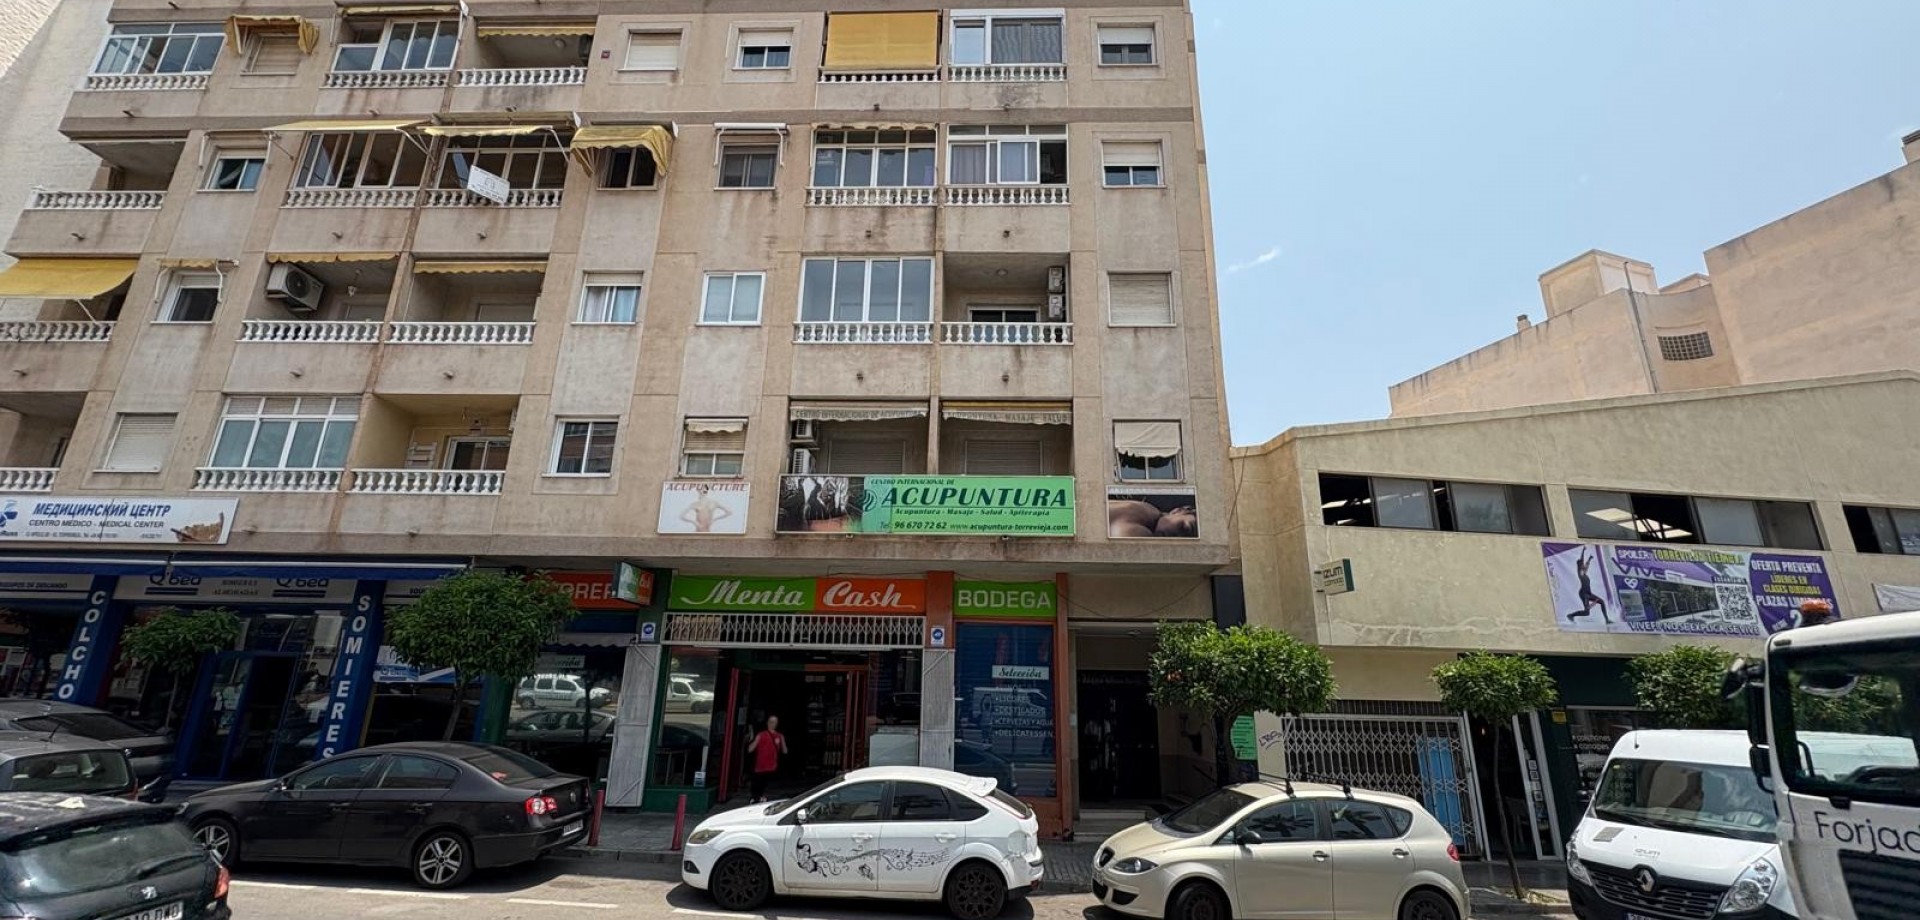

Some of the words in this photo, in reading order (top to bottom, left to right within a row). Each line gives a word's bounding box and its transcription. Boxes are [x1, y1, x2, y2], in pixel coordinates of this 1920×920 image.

[881, 487, 1067, 507] ACUPUNTURA
[33, 502, 128, 518] МЕДИЦИНСКИЙ
[130, 503, 172, 519] ЦЕНТР
[895, 508, 940, 516] Acupuntura
[947, 508, 974, 516] Masaje
[981, 508, 1003, 516] Salud
[1009, 508, 1050, 517] Apiterapia
[29, 519, 60, 527] CENTRO
[98, 520, 132, 528] MEDICAL
[134, 520, 164, 528] CENTER
[894, 521, 906, 529] 96
[906, 521, 923, 529] 670
[924, 521, 935, 529] 72
[935, 521, 947, 529] 62
[1751, 560, 1781, 572] OFERTA
[1782, 561, 1823, 574] PREVENTA
[680, 580, 805, 606] Menta
[823, 581, 917, 609] Cash
[958, 590, 1051, 609] BODEGA
[1756, 595, 1788, 607] PLAZAS
[58, 590, 107, 699] COLCHO
[322, 595, 371, 759] SOMIERES
[999, 667, 1042, 678] Selección
